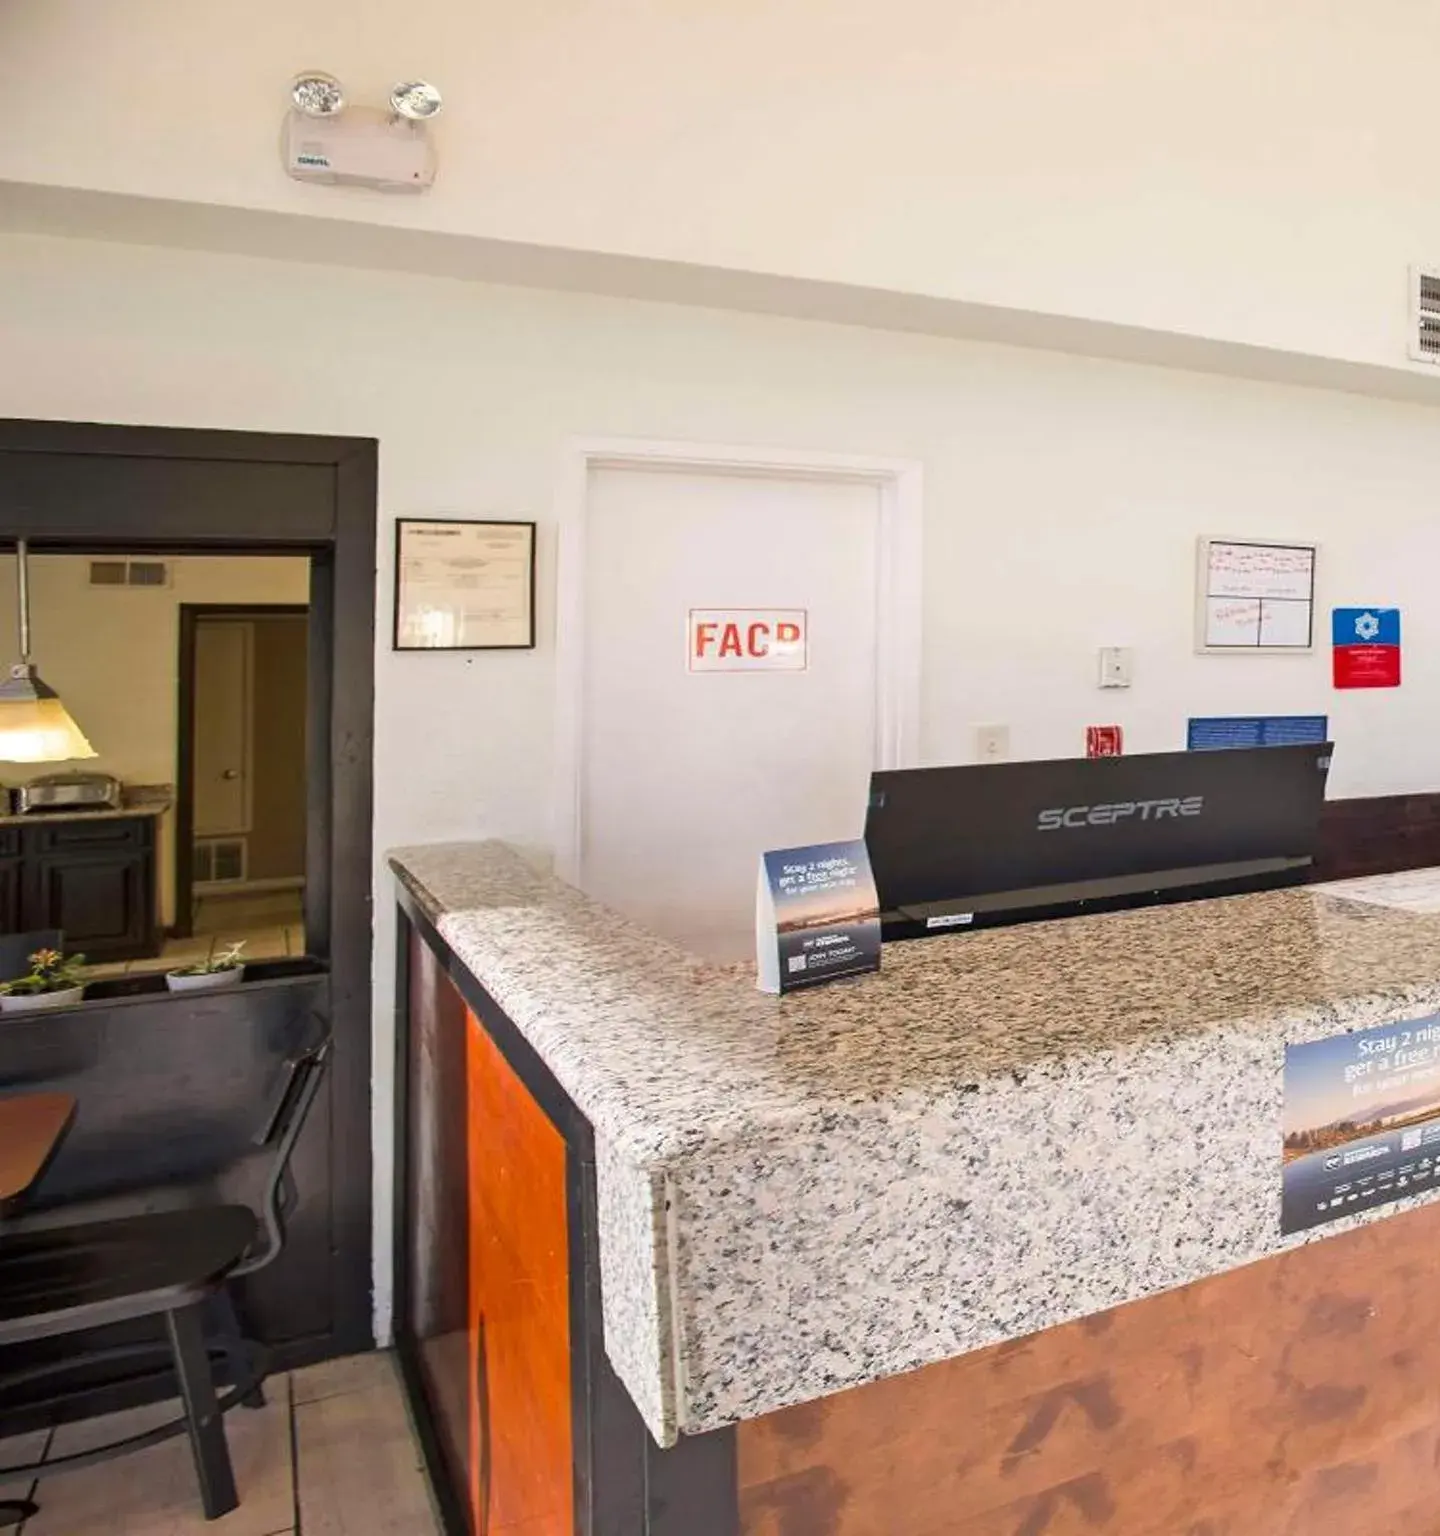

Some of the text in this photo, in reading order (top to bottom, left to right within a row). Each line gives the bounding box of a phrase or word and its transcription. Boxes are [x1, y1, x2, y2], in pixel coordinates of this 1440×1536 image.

[1037, 796, 1203, 831] SCEPTRE
[1358, 1036, 1397, 1055] Stay
[1400, 1031, 1412, 1047] 2
[1344, 1061, 1373, 1083] get
[1377, 1058, 1390, 1071] a
[1394, 1046, 1430, 1068] free
